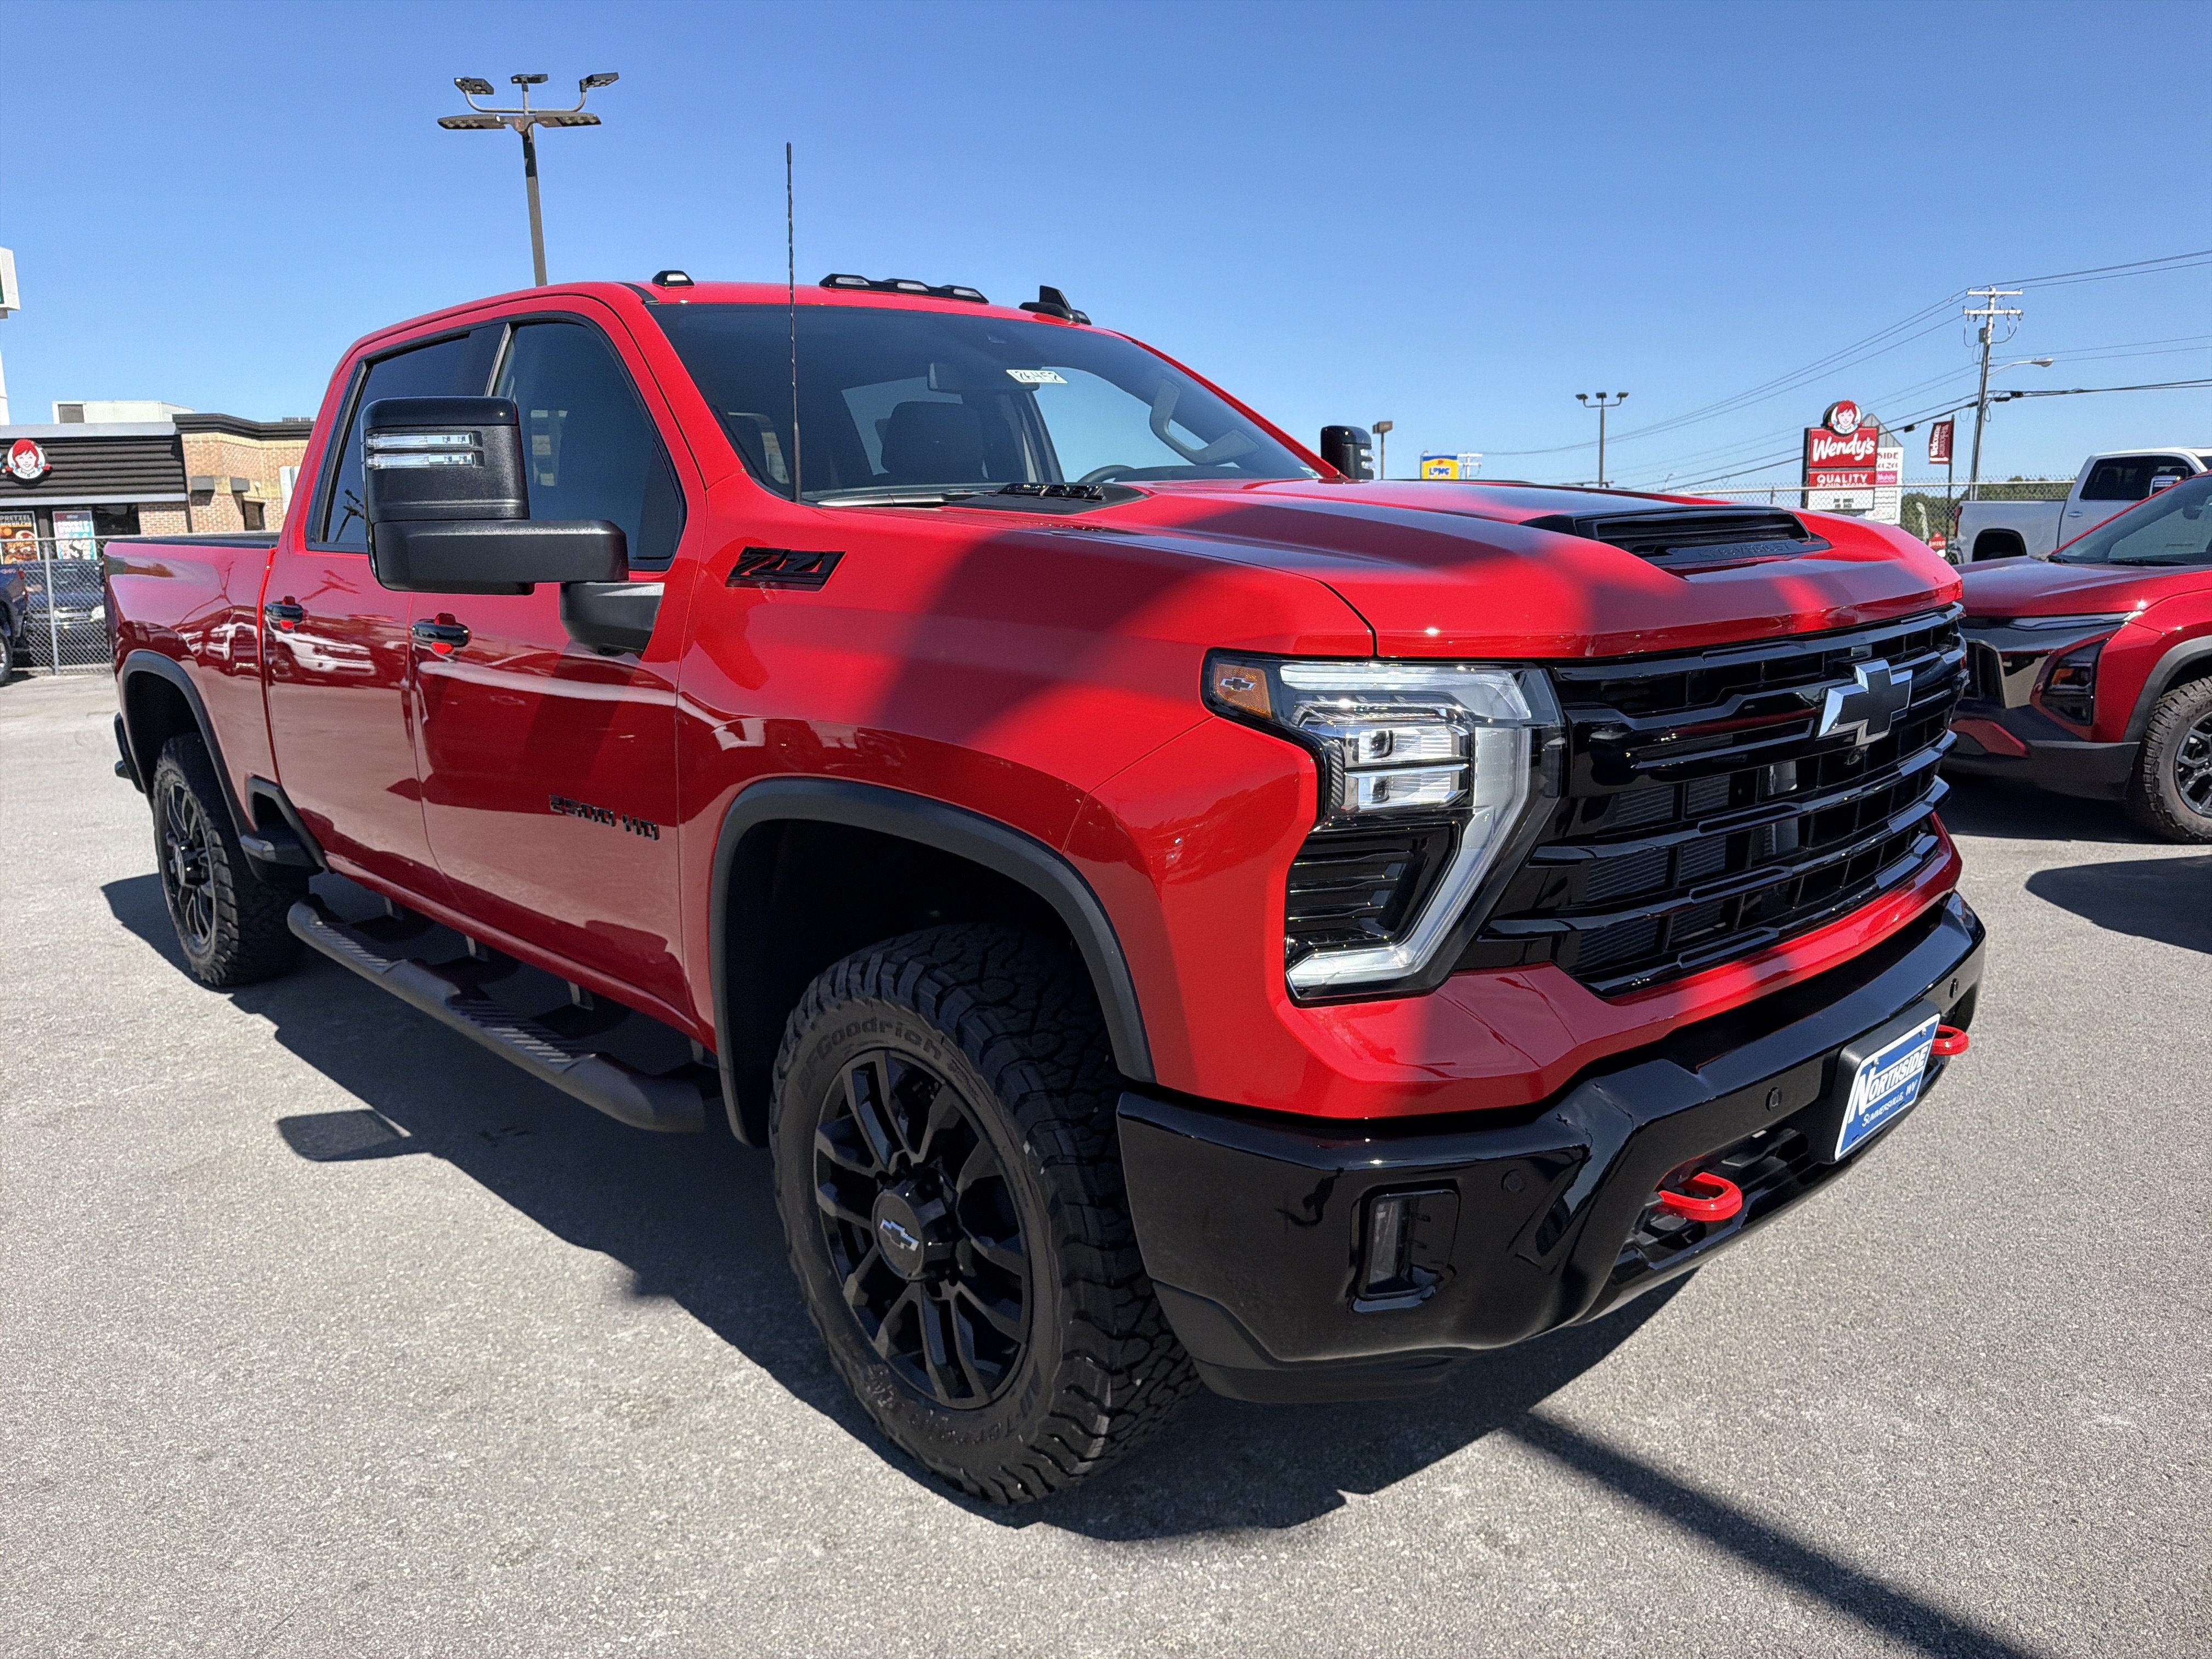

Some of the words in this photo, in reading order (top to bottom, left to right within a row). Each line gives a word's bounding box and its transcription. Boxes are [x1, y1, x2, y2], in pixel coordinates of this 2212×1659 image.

[1813, 433, 1876, 461] Wendy's
[1816, 473, 1868, 484] QUALITY
[550, 794, 616, 827] 2500
[622, 813, 660, 841] HD
[1848, 1046, 1929, 1124] NORTHSIDE
[1905, 1079, 1918, 1096] WV
